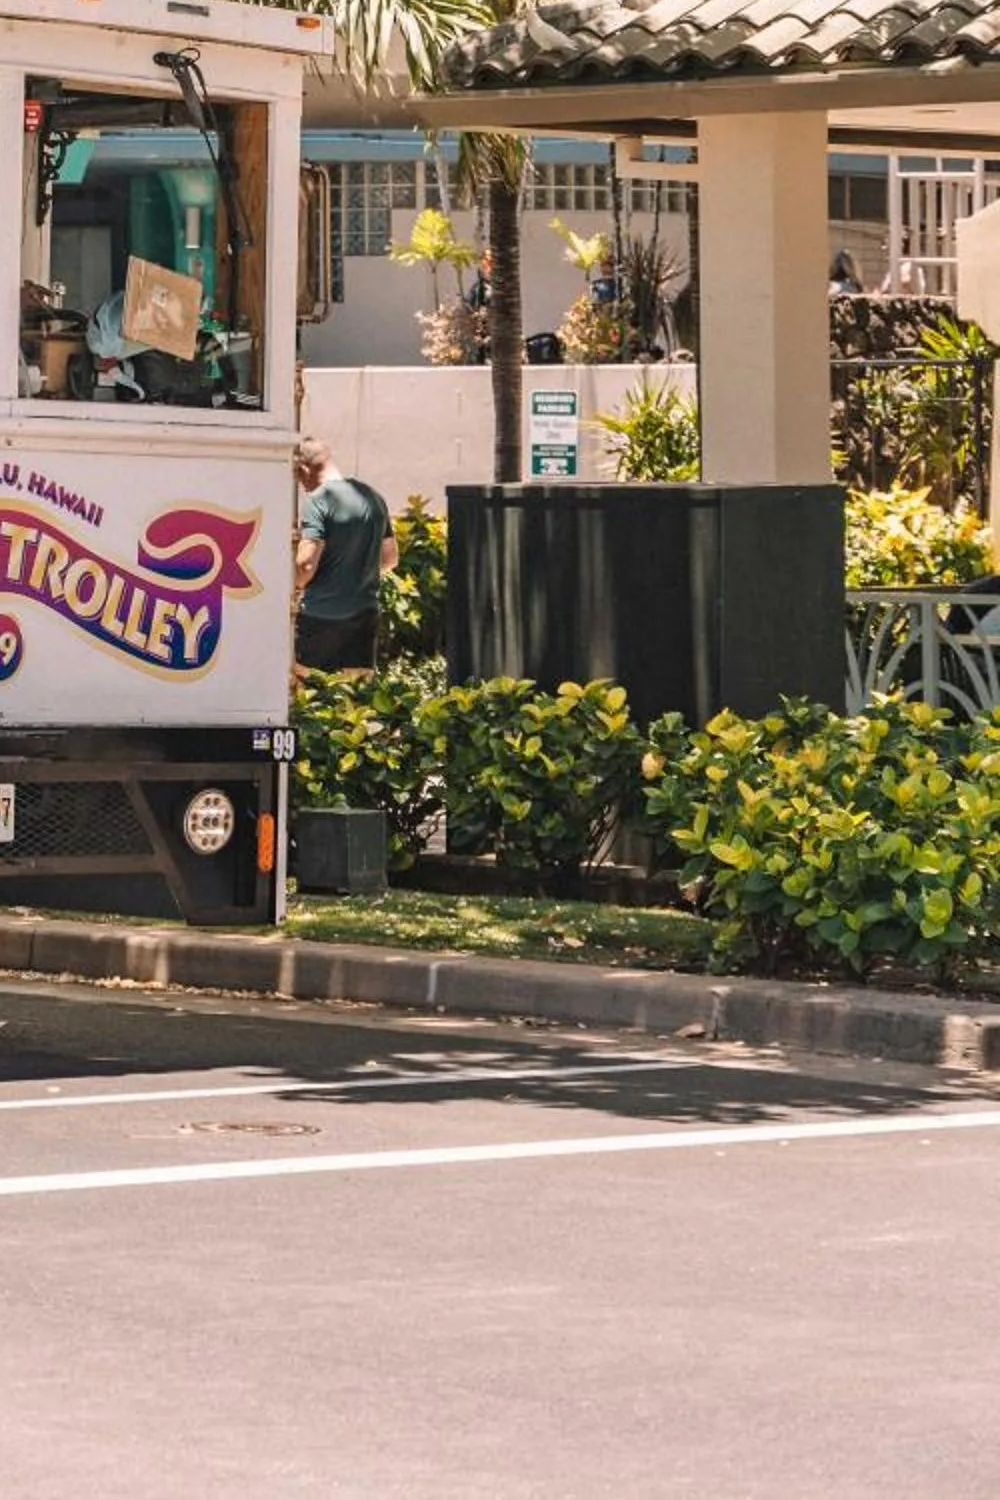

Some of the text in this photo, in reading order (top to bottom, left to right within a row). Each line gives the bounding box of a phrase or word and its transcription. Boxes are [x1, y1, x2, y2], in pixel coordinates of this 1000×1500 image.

[27, 471, 105, 527] HAWAII
[0, 521, 211, 664] TROLLEY
[273, 729, 295, 760] 99
